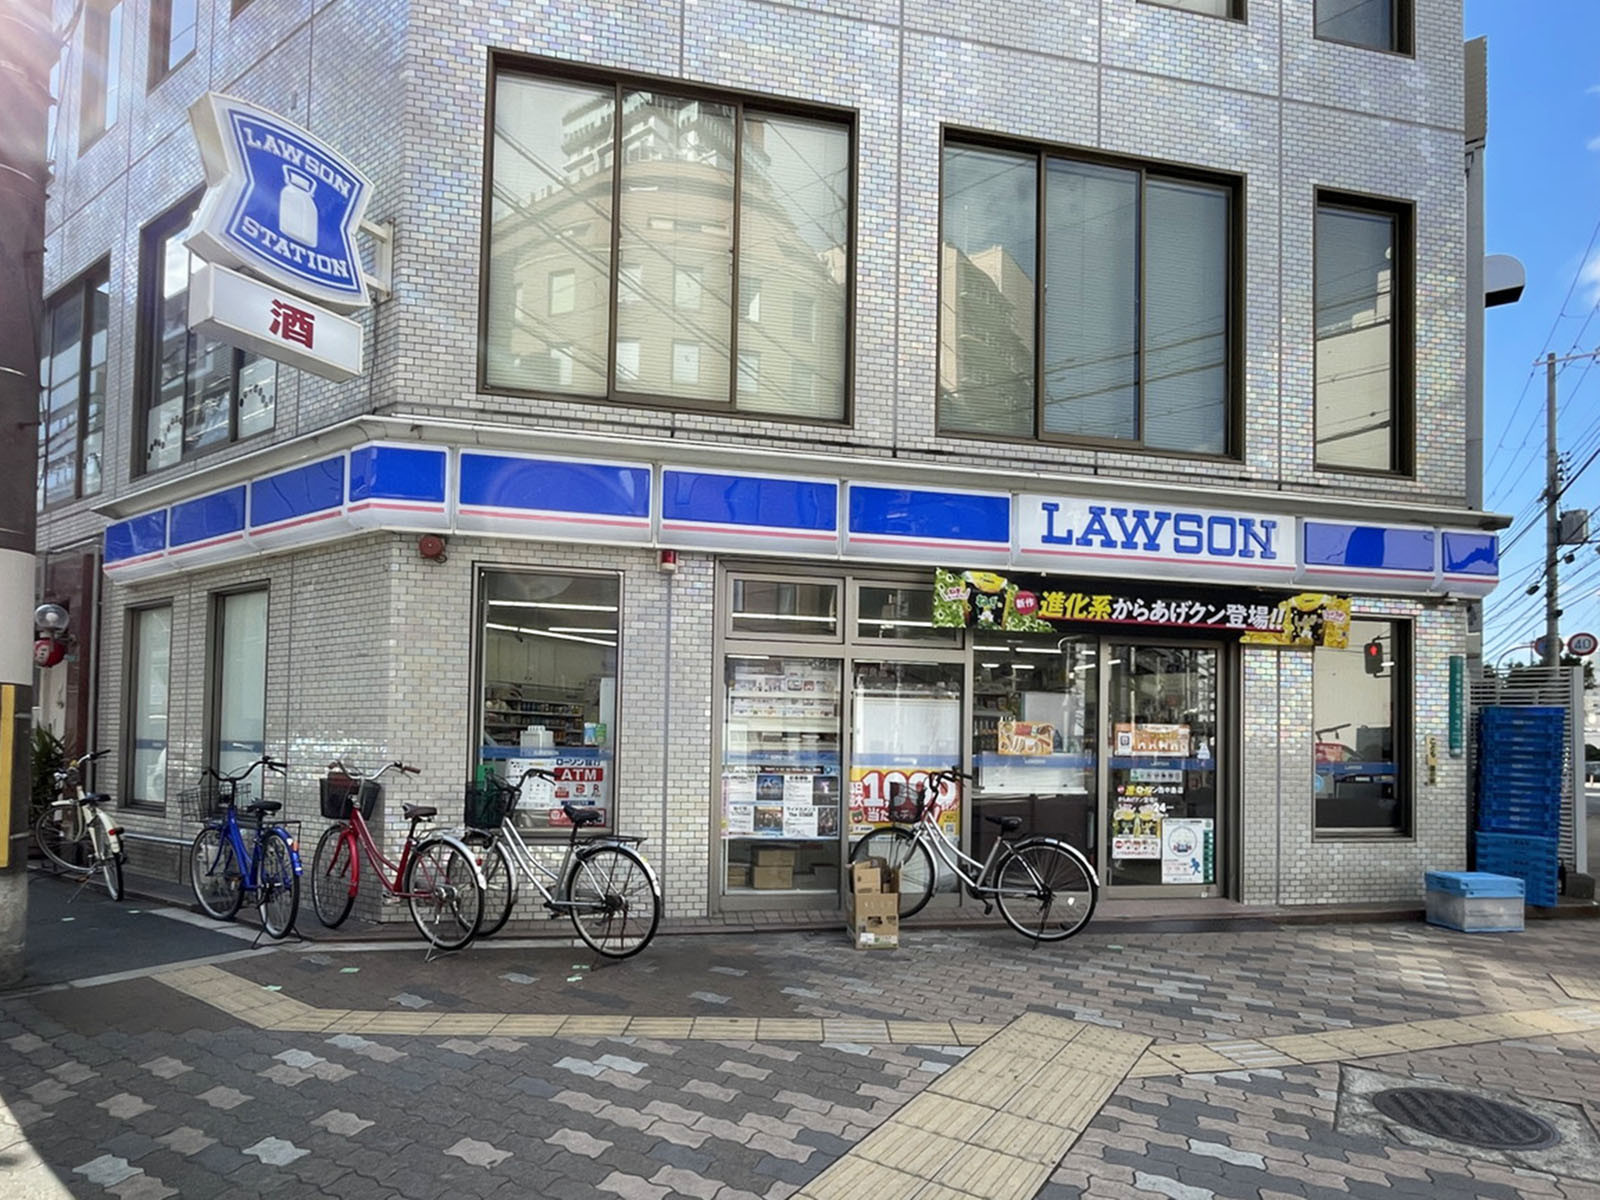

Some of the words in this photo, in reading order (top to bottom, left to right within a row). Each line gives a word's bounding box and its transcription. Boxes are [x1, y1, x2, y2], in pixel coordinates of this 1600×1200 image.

[245, 127, 352, 198] LAWSON
[241, 216, 349, 278] STATION
[269, 299, 315, 349] 酒
[1041, 502, 1277, 559] LAWSON
[561, 769, 597, 780] ATM
